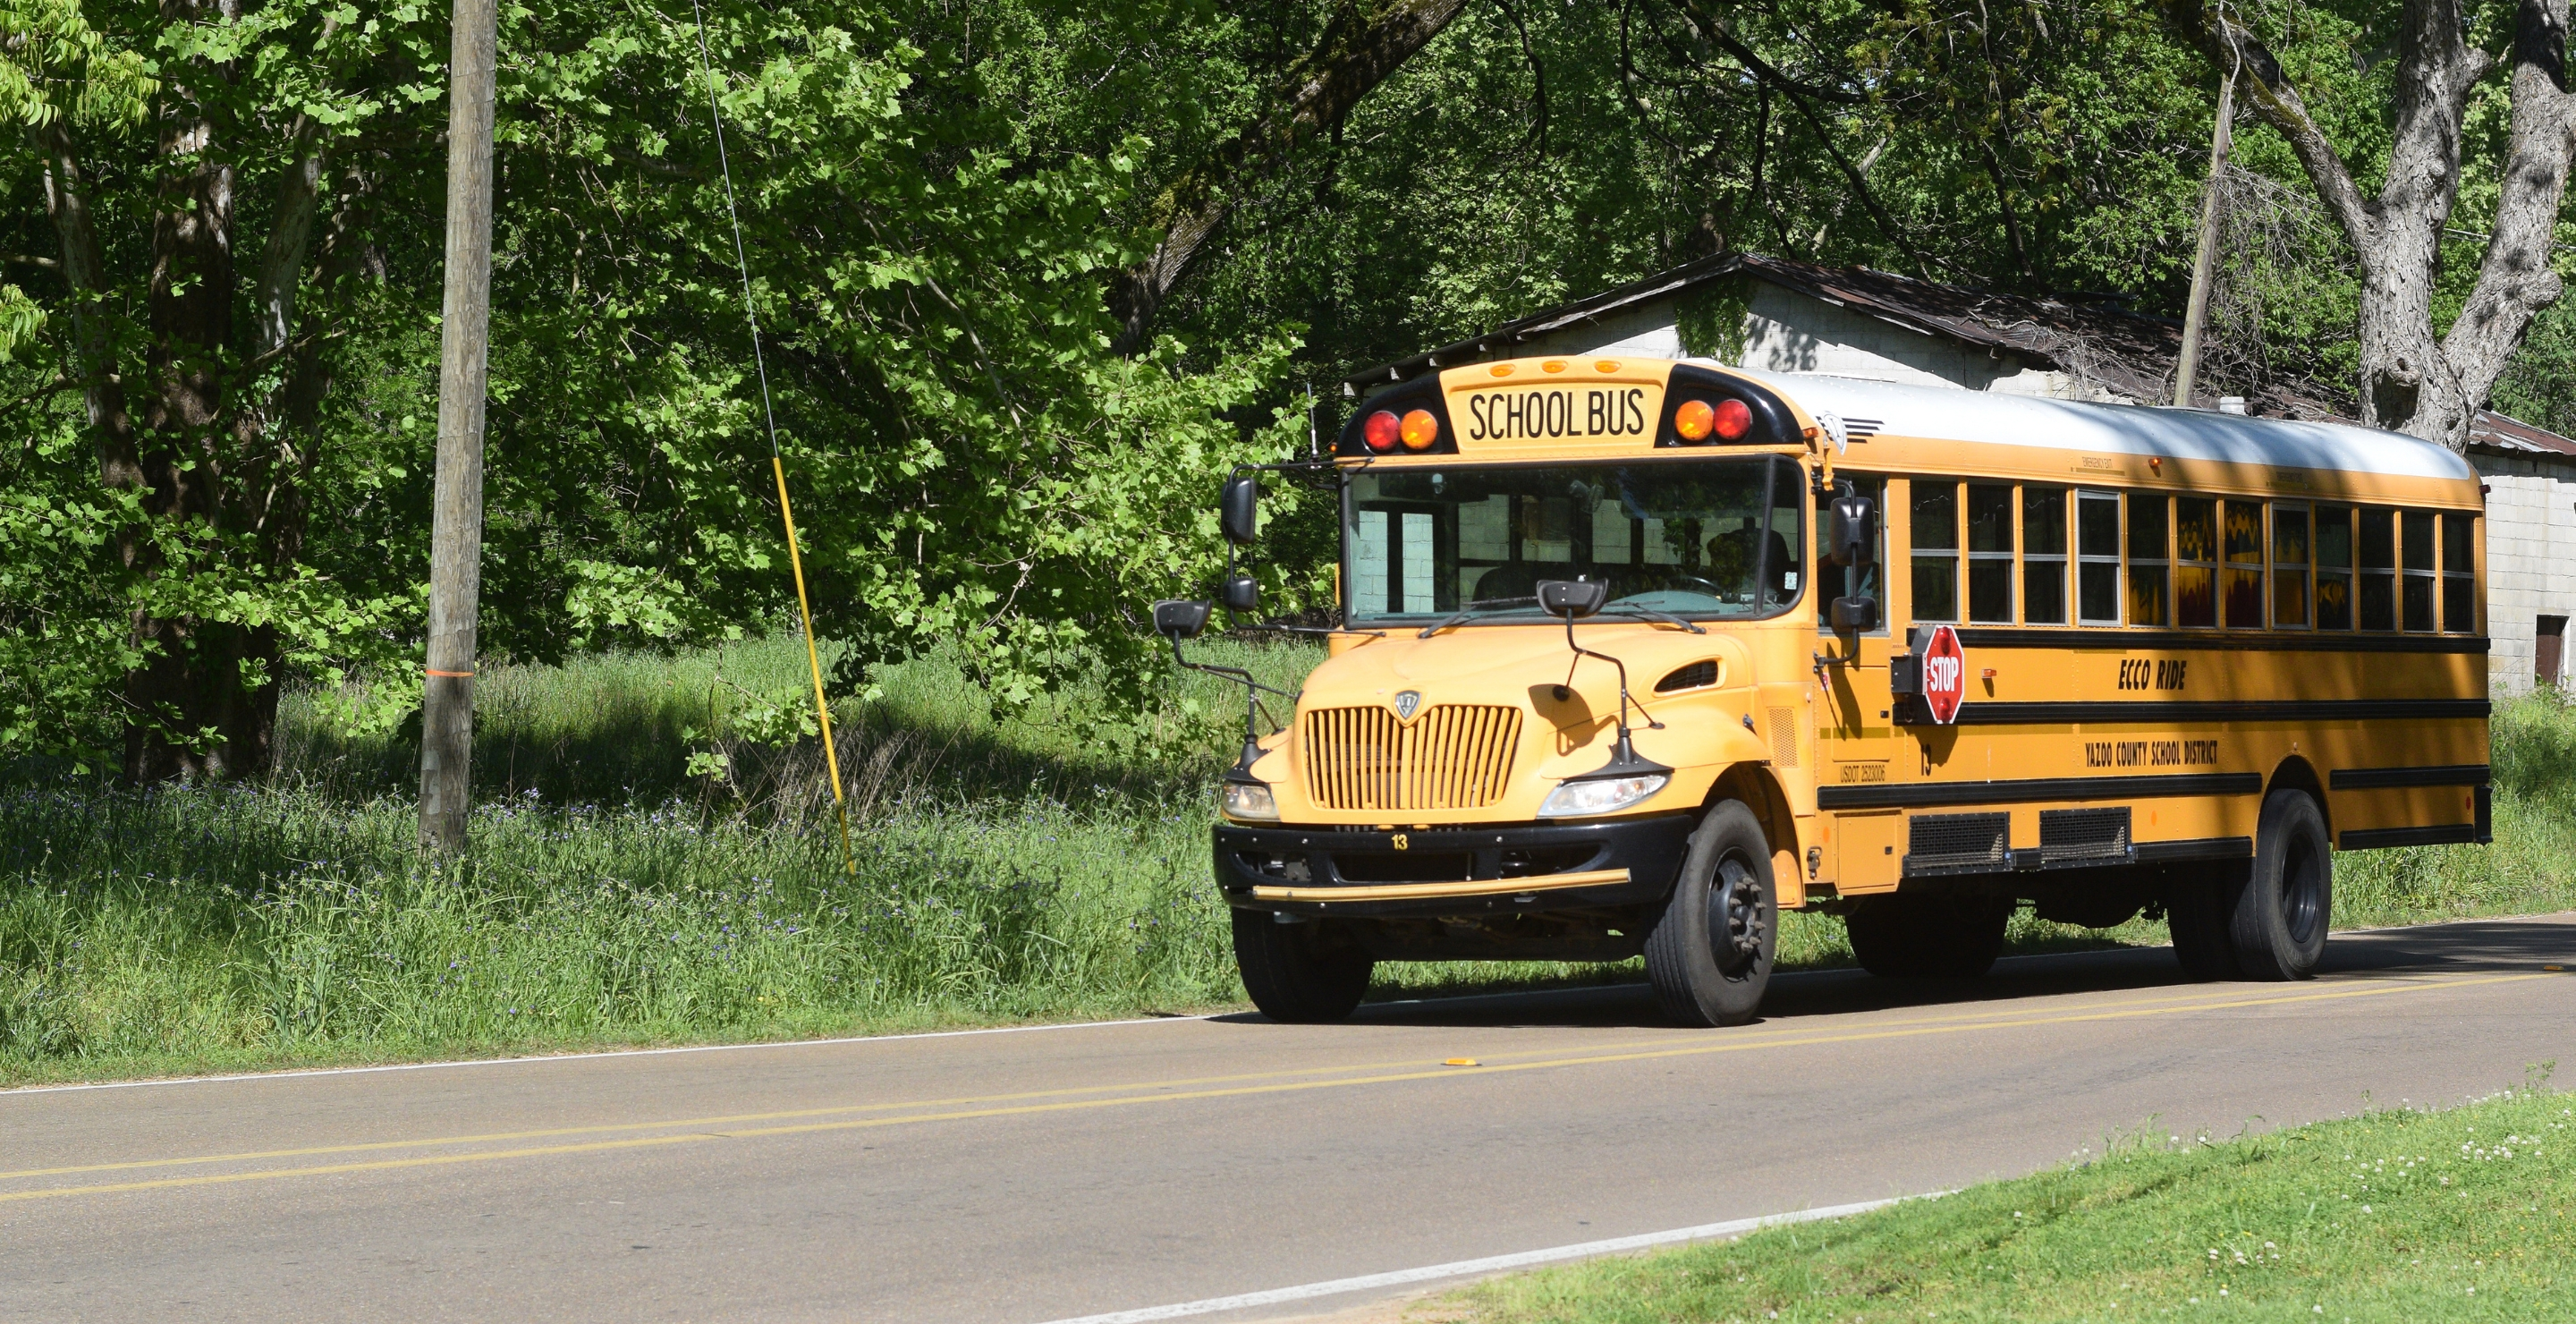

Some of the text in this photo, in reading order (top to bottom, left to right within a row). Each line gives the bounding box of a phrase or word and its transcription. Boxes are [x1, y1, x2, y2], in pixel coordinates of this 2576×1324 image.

[1470, 388, 1644, 440] SCHOOL BUS
[1929, 656, 1960, 692] STOP
[2118, 658, 2187, 691] ECCO RIDE
[1920, 743, 1932, 777] 13
[2085, 740, 2218, 768] YAZOO COUNTY SCHOOL DISTRICT
[1840, 765, 1860, 783] USDOT
[1391, 834, 1408, 850] 13
